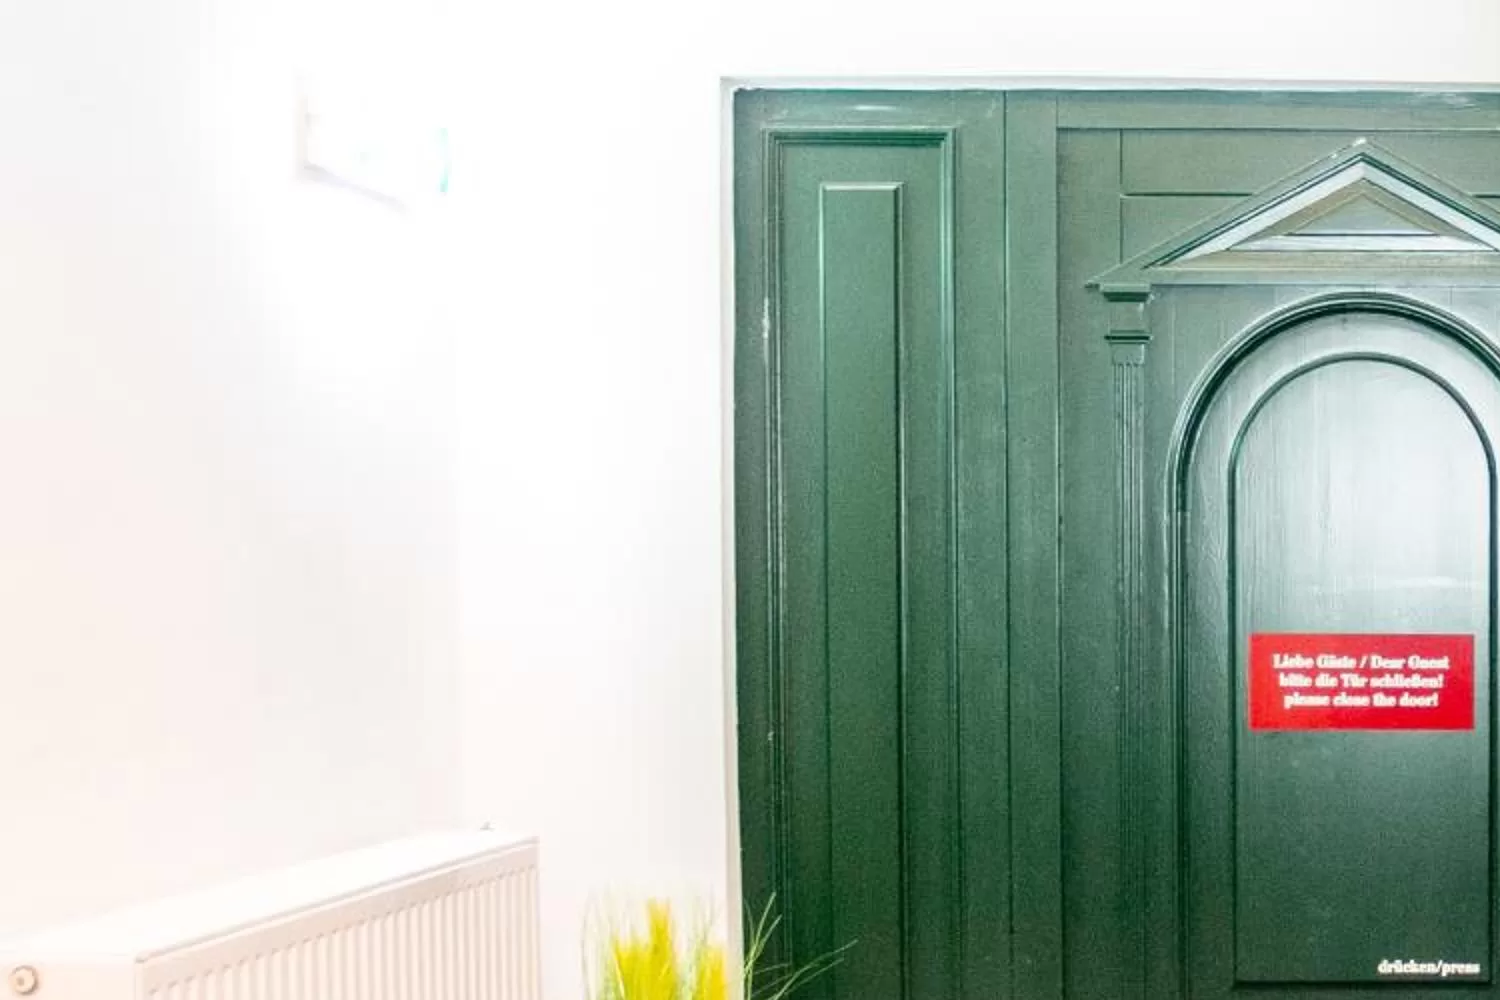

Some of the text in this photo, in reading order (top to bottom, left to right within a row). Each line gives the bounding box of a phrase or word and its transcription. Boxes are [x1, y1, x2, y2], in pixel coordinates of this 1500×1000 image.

[1272, 653, 1450, 670] Liebe Gäste / Dear Guest
[1279, 672, 1444, 688] bitte die Tür schließen!
[1283, 691, 1439, 710] please close the door!
